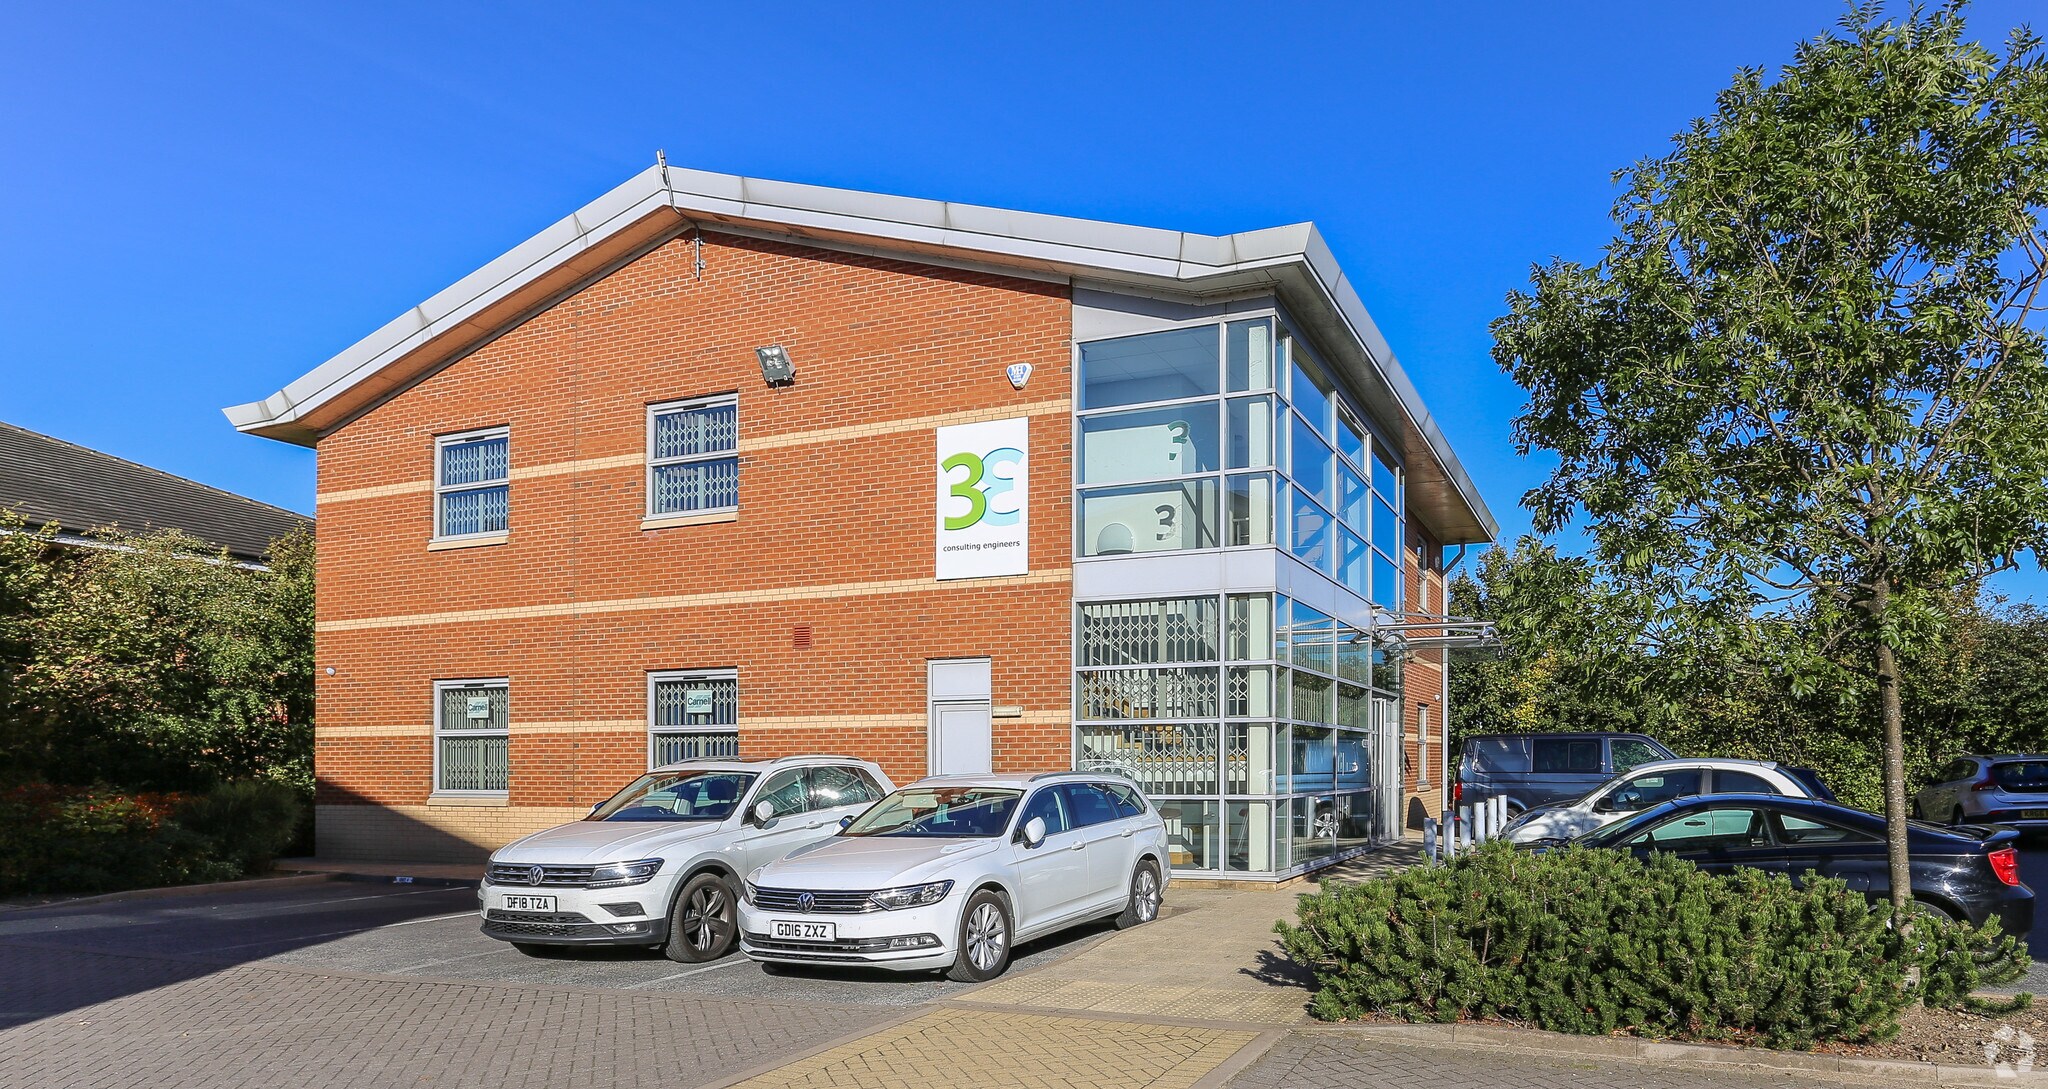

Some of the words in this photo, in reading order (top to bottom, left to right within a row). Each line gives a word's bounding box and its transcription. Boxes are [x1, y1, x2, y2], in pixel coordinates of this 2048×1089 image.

[943, 543, 981, 553] consulting
[983, 540, 1021, 551] engineers
[507, 896, 528, 909] DF18
[530, 897, 549, 910] TZA
[777, 923, 801, 937] GD16
[804, 924, 827, 938] ZXZ
